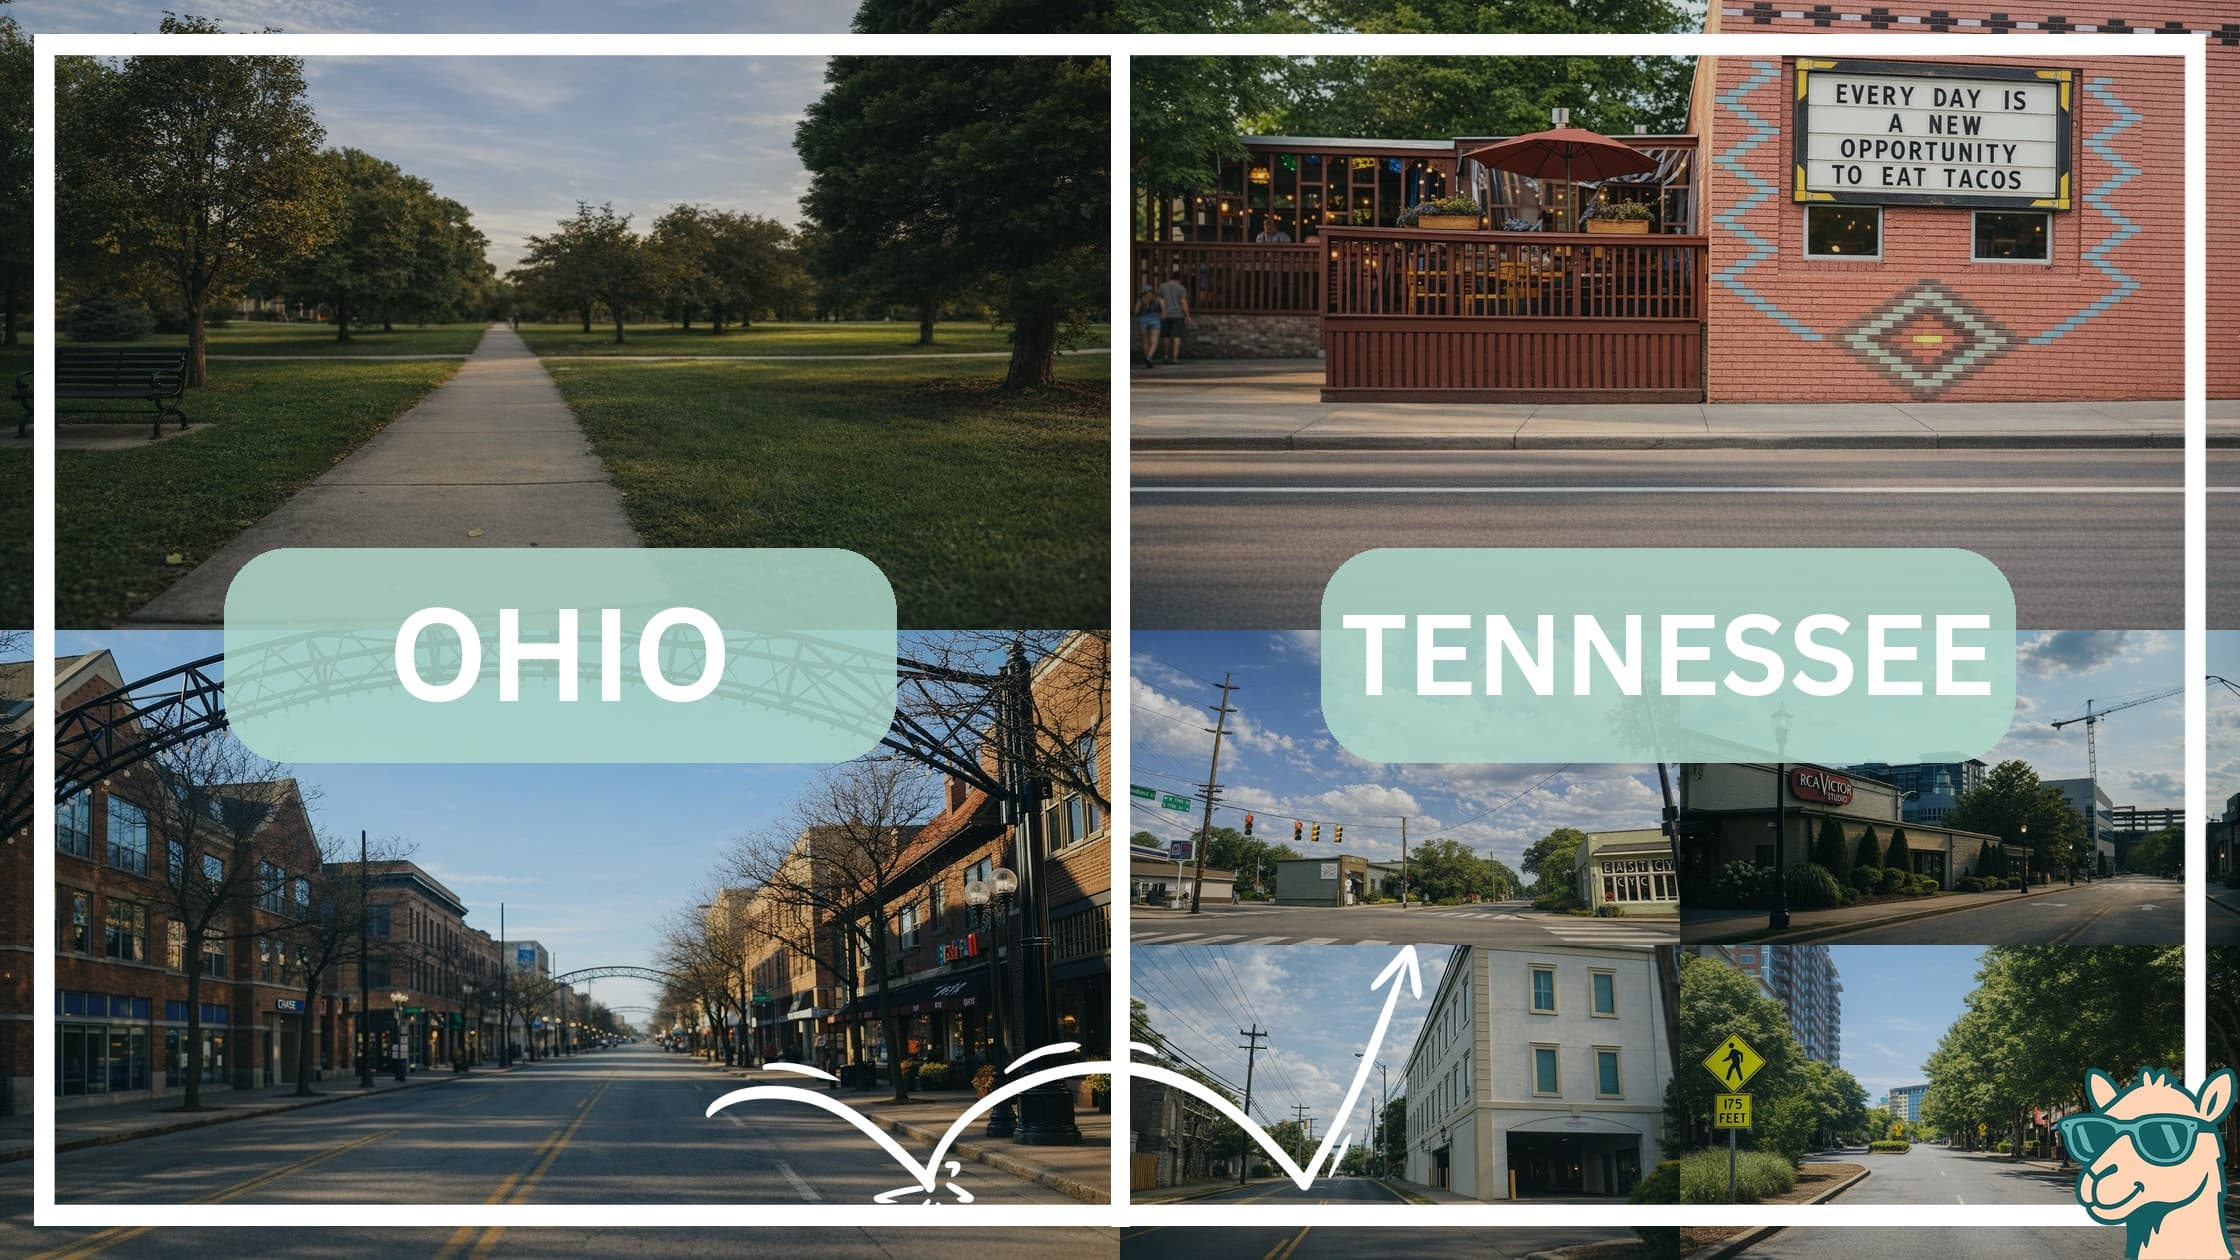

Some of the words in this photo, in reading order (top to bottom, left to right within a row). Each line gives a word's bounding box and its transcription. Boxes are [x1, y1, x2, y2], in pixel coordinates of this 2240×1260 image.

[1836, 84, 1915, 106] EVERY
[1933, 87, 1982, 109] DAY
[2003, 90, 2027, 111] IS
[1888, 113, 1904, 133] A
[1928, 114, 1982, 136] NEW
[1840, 139, 2017, 164] OPPORTUNITY
[1832, 164, 1863, 185] TO
[1882, 166, 1927, 187] EAT
[1943, 168, 2022, 190] TACOS
[1801, 774, 1819, 789] RCA
[1820, 772, 1851, 795] VICTOR
[1604, 862, 1646, 873] EAST
[1617, 876, 1648, 887] CYC
[278, 999, 296, 1010] CHASE
[1724, 1099, 1742, 1109] 175
[1720, 1113, 1745, 1123] FEET
